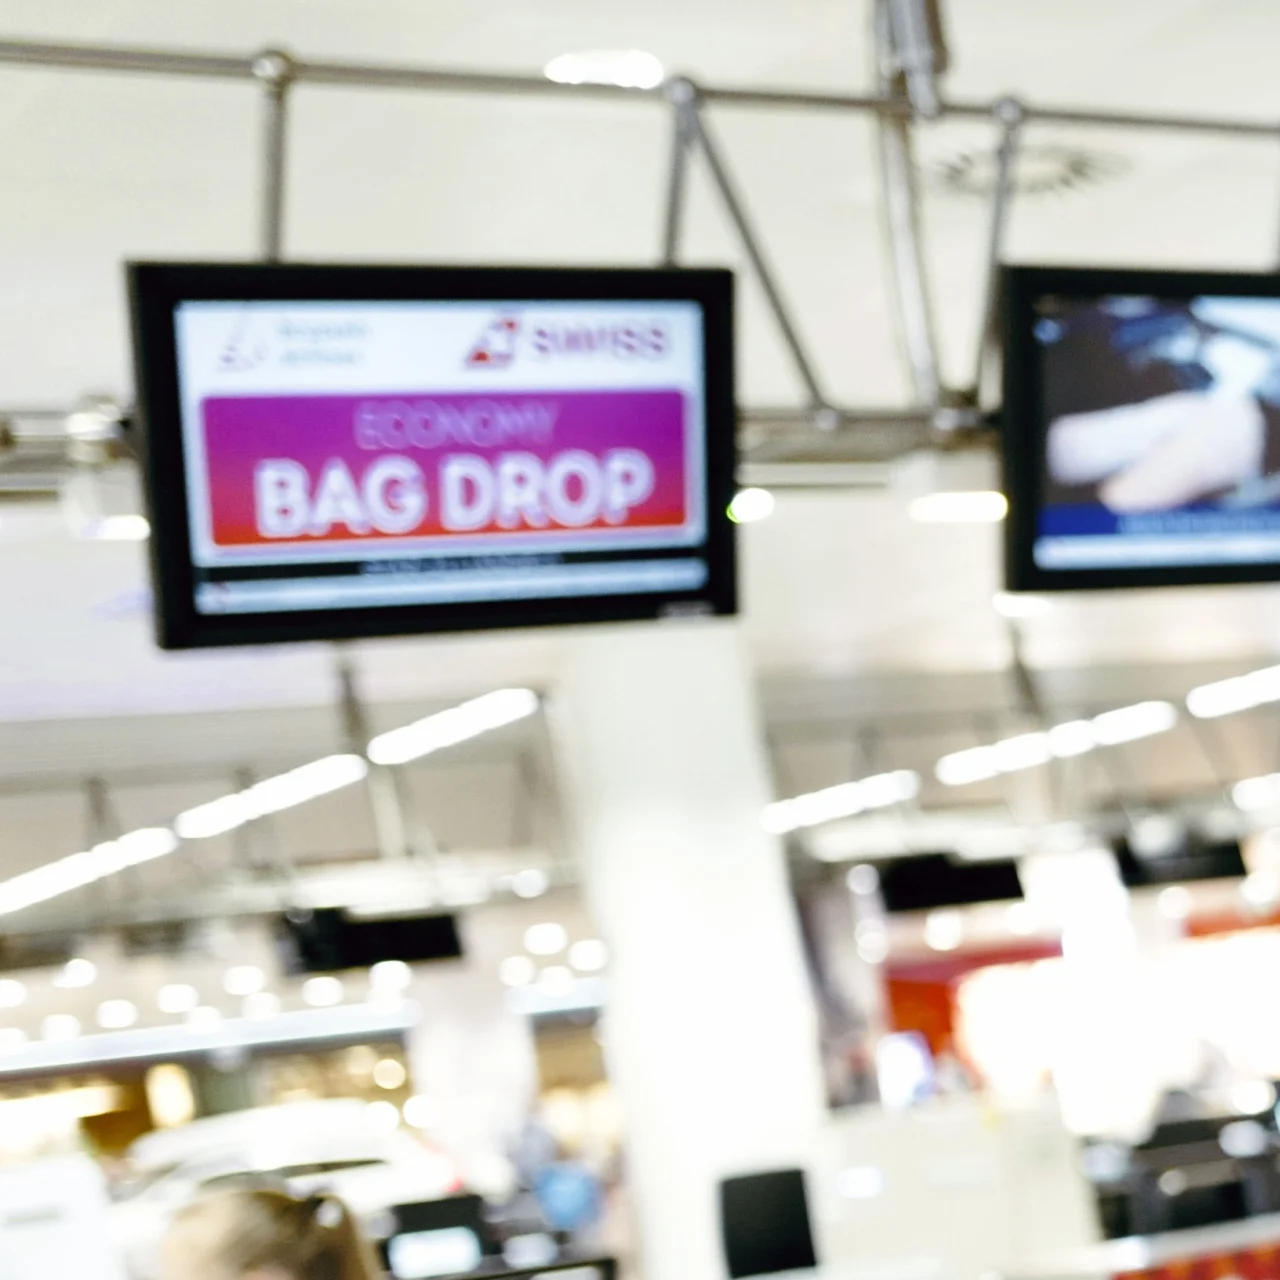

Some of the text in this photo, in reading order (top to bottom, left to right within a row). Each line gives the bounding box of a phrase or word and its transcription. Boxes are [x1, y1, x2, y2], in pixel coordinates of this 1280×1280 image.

[532, 321, 672, 360] SWISS
[354, 401, 559, 449] ECONOMY
[254, 448, 656, 538] BAG DROP
